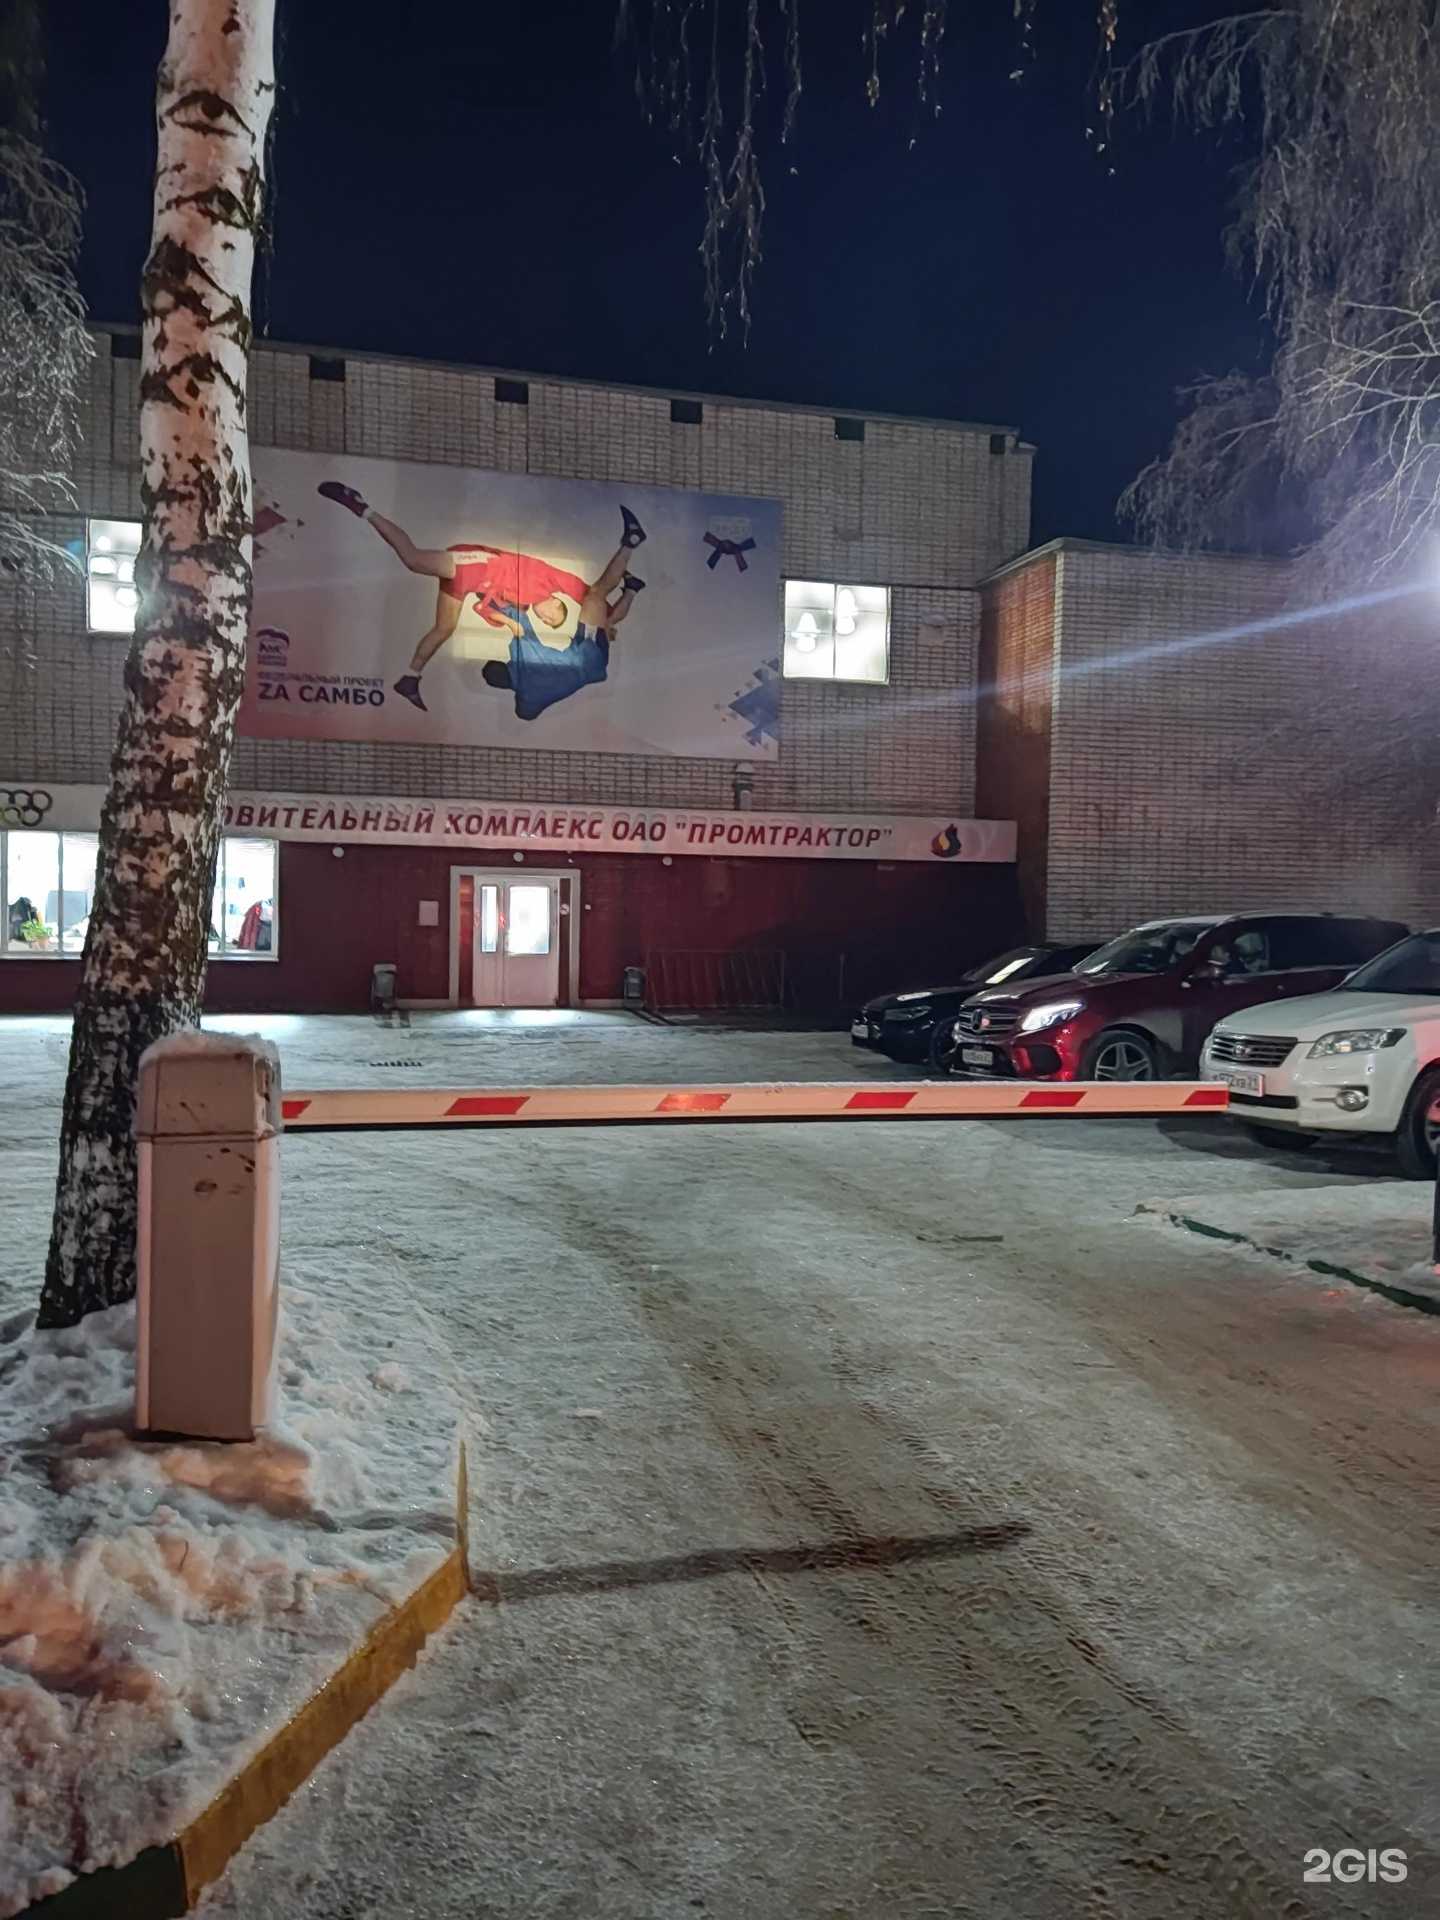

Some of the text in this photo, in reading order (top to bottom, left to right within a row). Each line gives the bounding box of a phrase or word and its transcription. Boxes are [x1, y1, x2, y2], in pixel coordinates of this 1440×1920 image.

[298, 684, 385, 707] САМБО
[444, 814, 602, 839] КОМПЛЕКС
[612, 820, 667, 842] ОАО
[675, 822, 893, 848] "ПРОМТРАКТОР"
